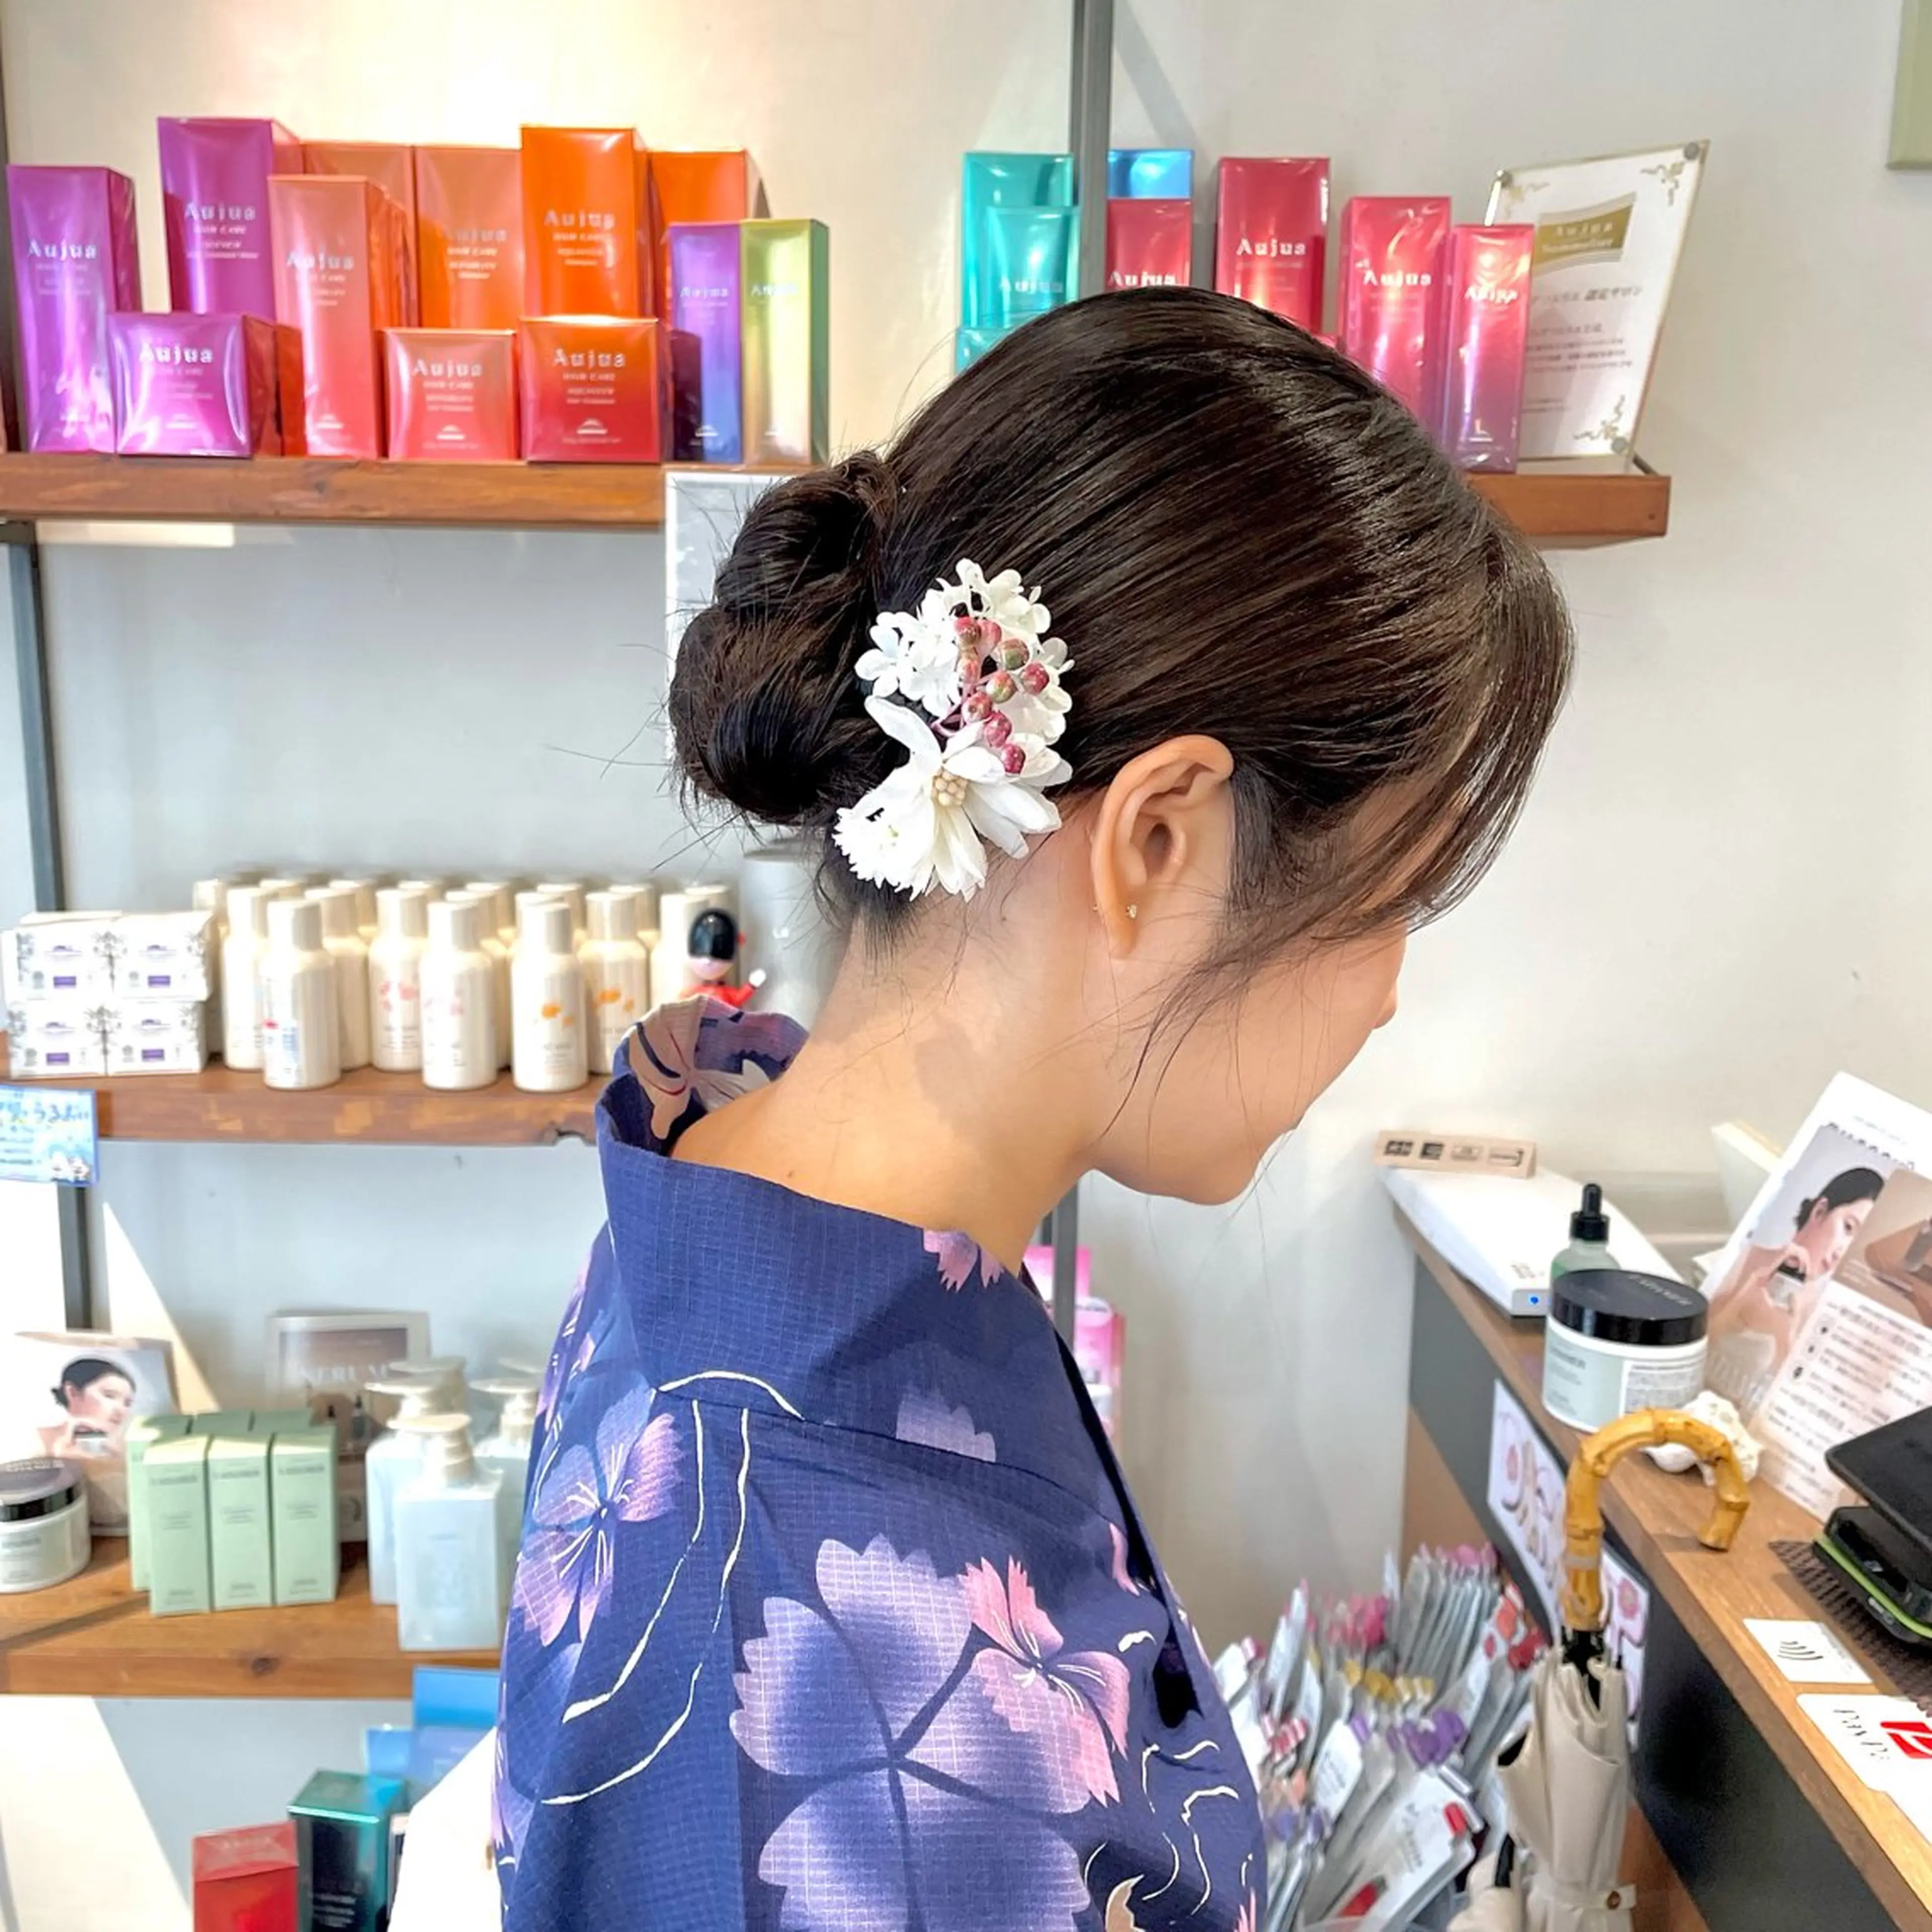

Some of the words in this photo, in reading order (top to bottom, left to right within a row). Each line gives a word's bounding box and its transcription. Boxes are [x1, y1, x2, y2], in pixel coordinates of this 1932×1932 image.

[27, 239, 97, 261] Aujua
[1236, 238, 1307, 258] Aujua
[412, 358, 482, 380] Aujua
[552, 347, 626, 370] Aujua
